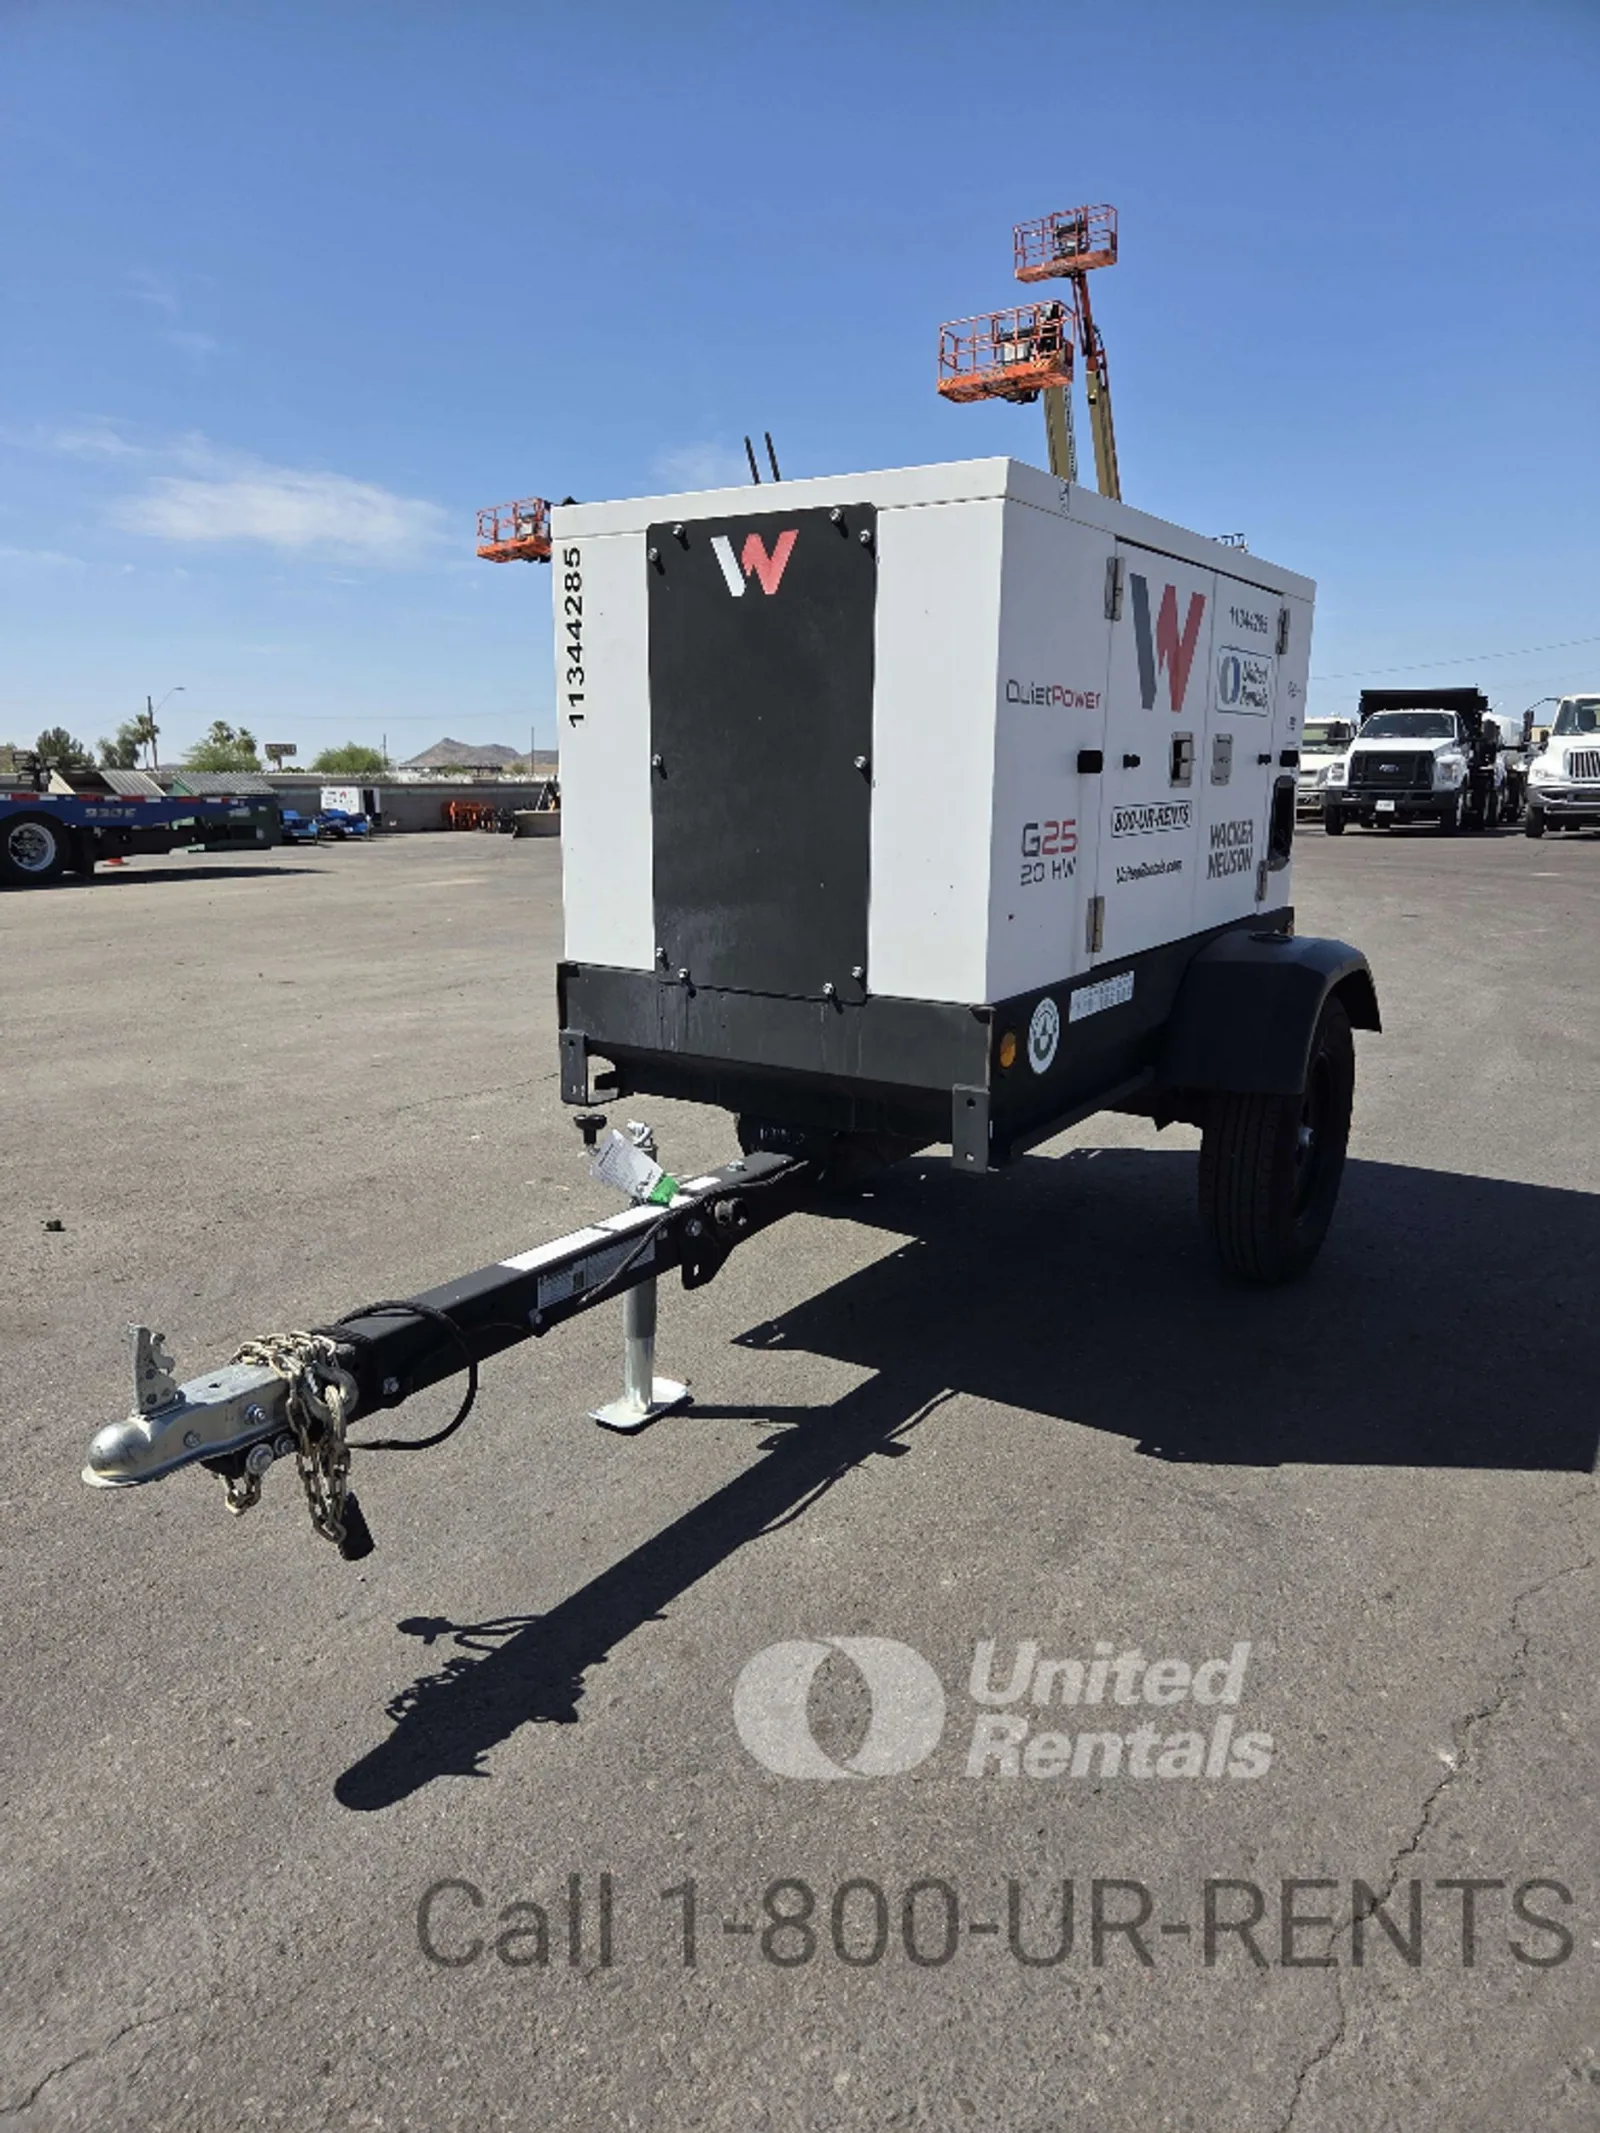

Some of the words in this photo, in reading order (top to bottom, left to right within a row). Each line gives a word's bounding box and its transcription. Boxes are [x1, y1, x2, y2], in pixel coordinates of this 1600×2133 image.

[563, 546, 585, 728] 11344285
[1021, 818, 1079, 858] G25
[1209, 818, 1254, 849] WACKER
[1019, 861, 1046, 887] 20
[1205, 847, 1254, 881] NEUSON
